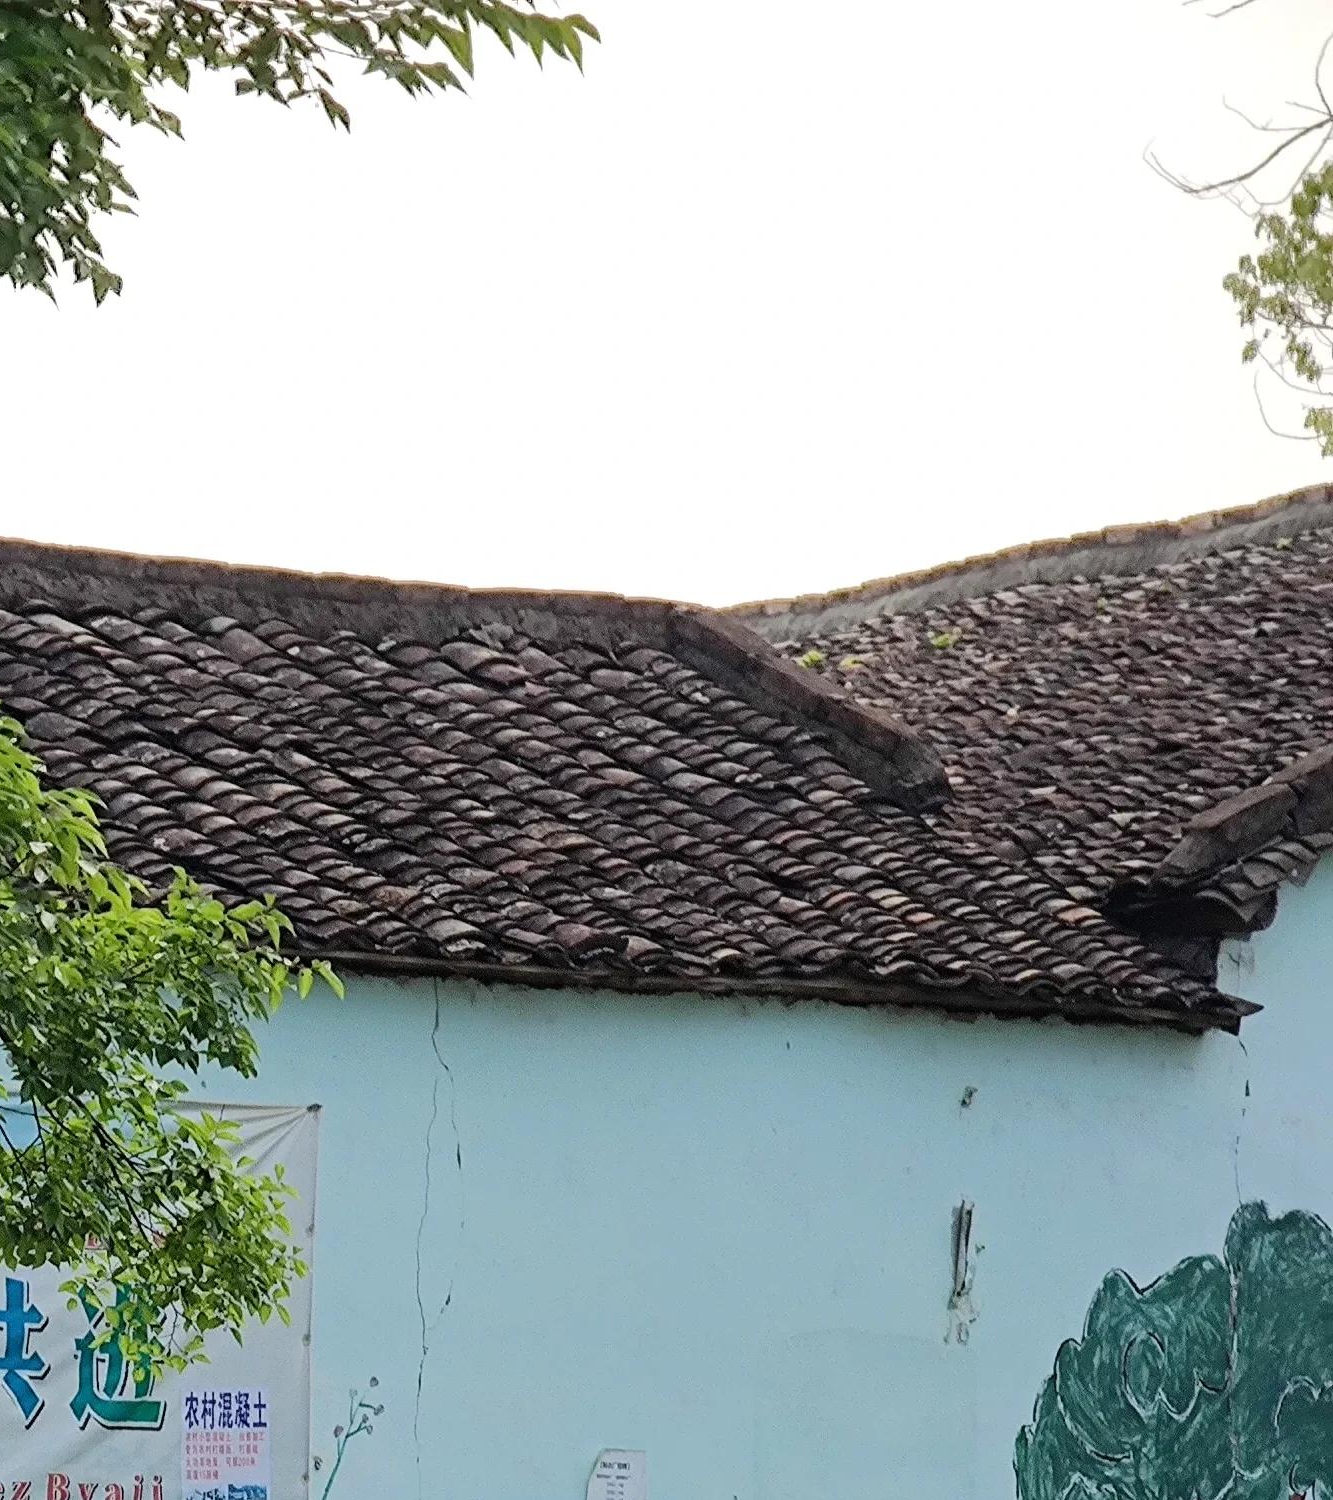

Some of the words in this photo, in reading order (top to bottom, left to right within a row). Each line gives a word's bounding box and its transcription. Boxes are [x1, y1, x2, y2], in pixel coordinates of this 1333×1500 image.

[184, 1391, 267, 1430] 农村混凝土
